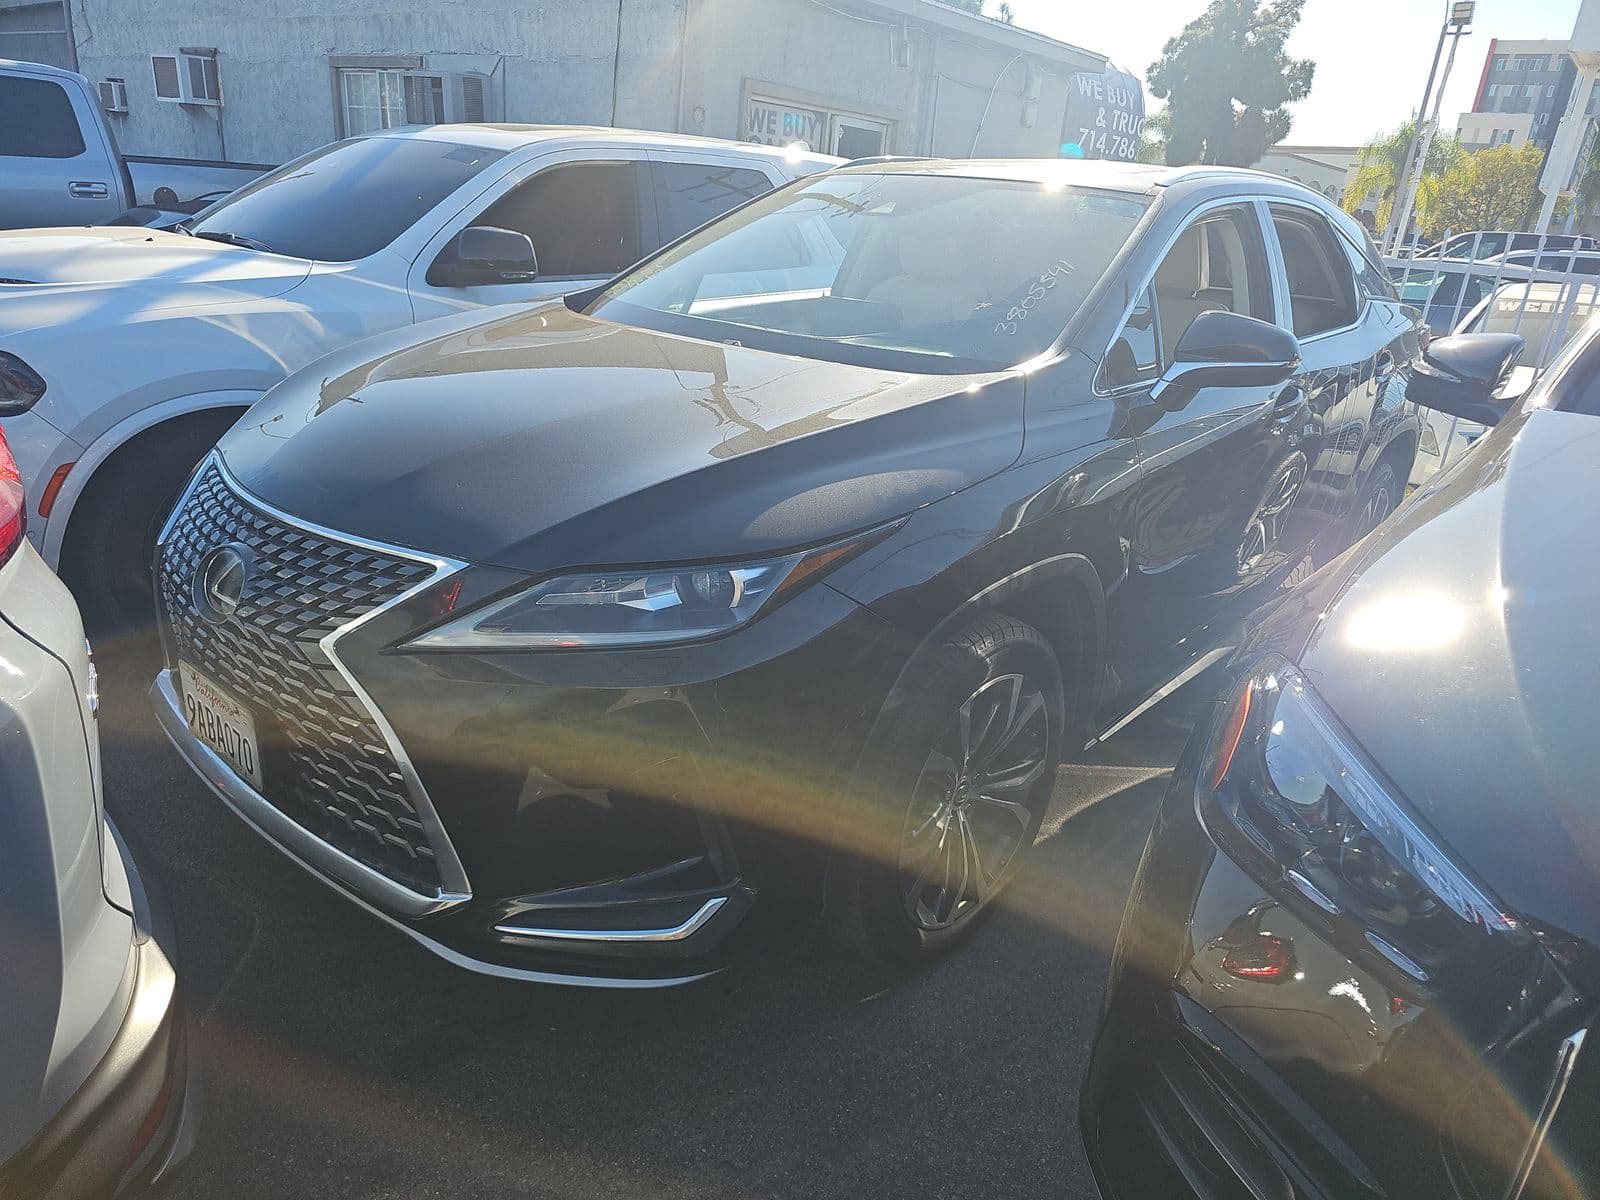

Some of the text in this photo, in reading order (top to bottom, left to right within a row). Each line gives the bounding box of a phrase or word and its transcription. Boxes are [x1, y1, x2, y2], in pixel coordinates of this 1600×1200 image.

[1077, 75, 1135, 111] WE BUY
[750, 106, 819, 141] WE BUY
[1095, 106, 1106, 128] &
[186, 692, 255, 776] 9ABA070
